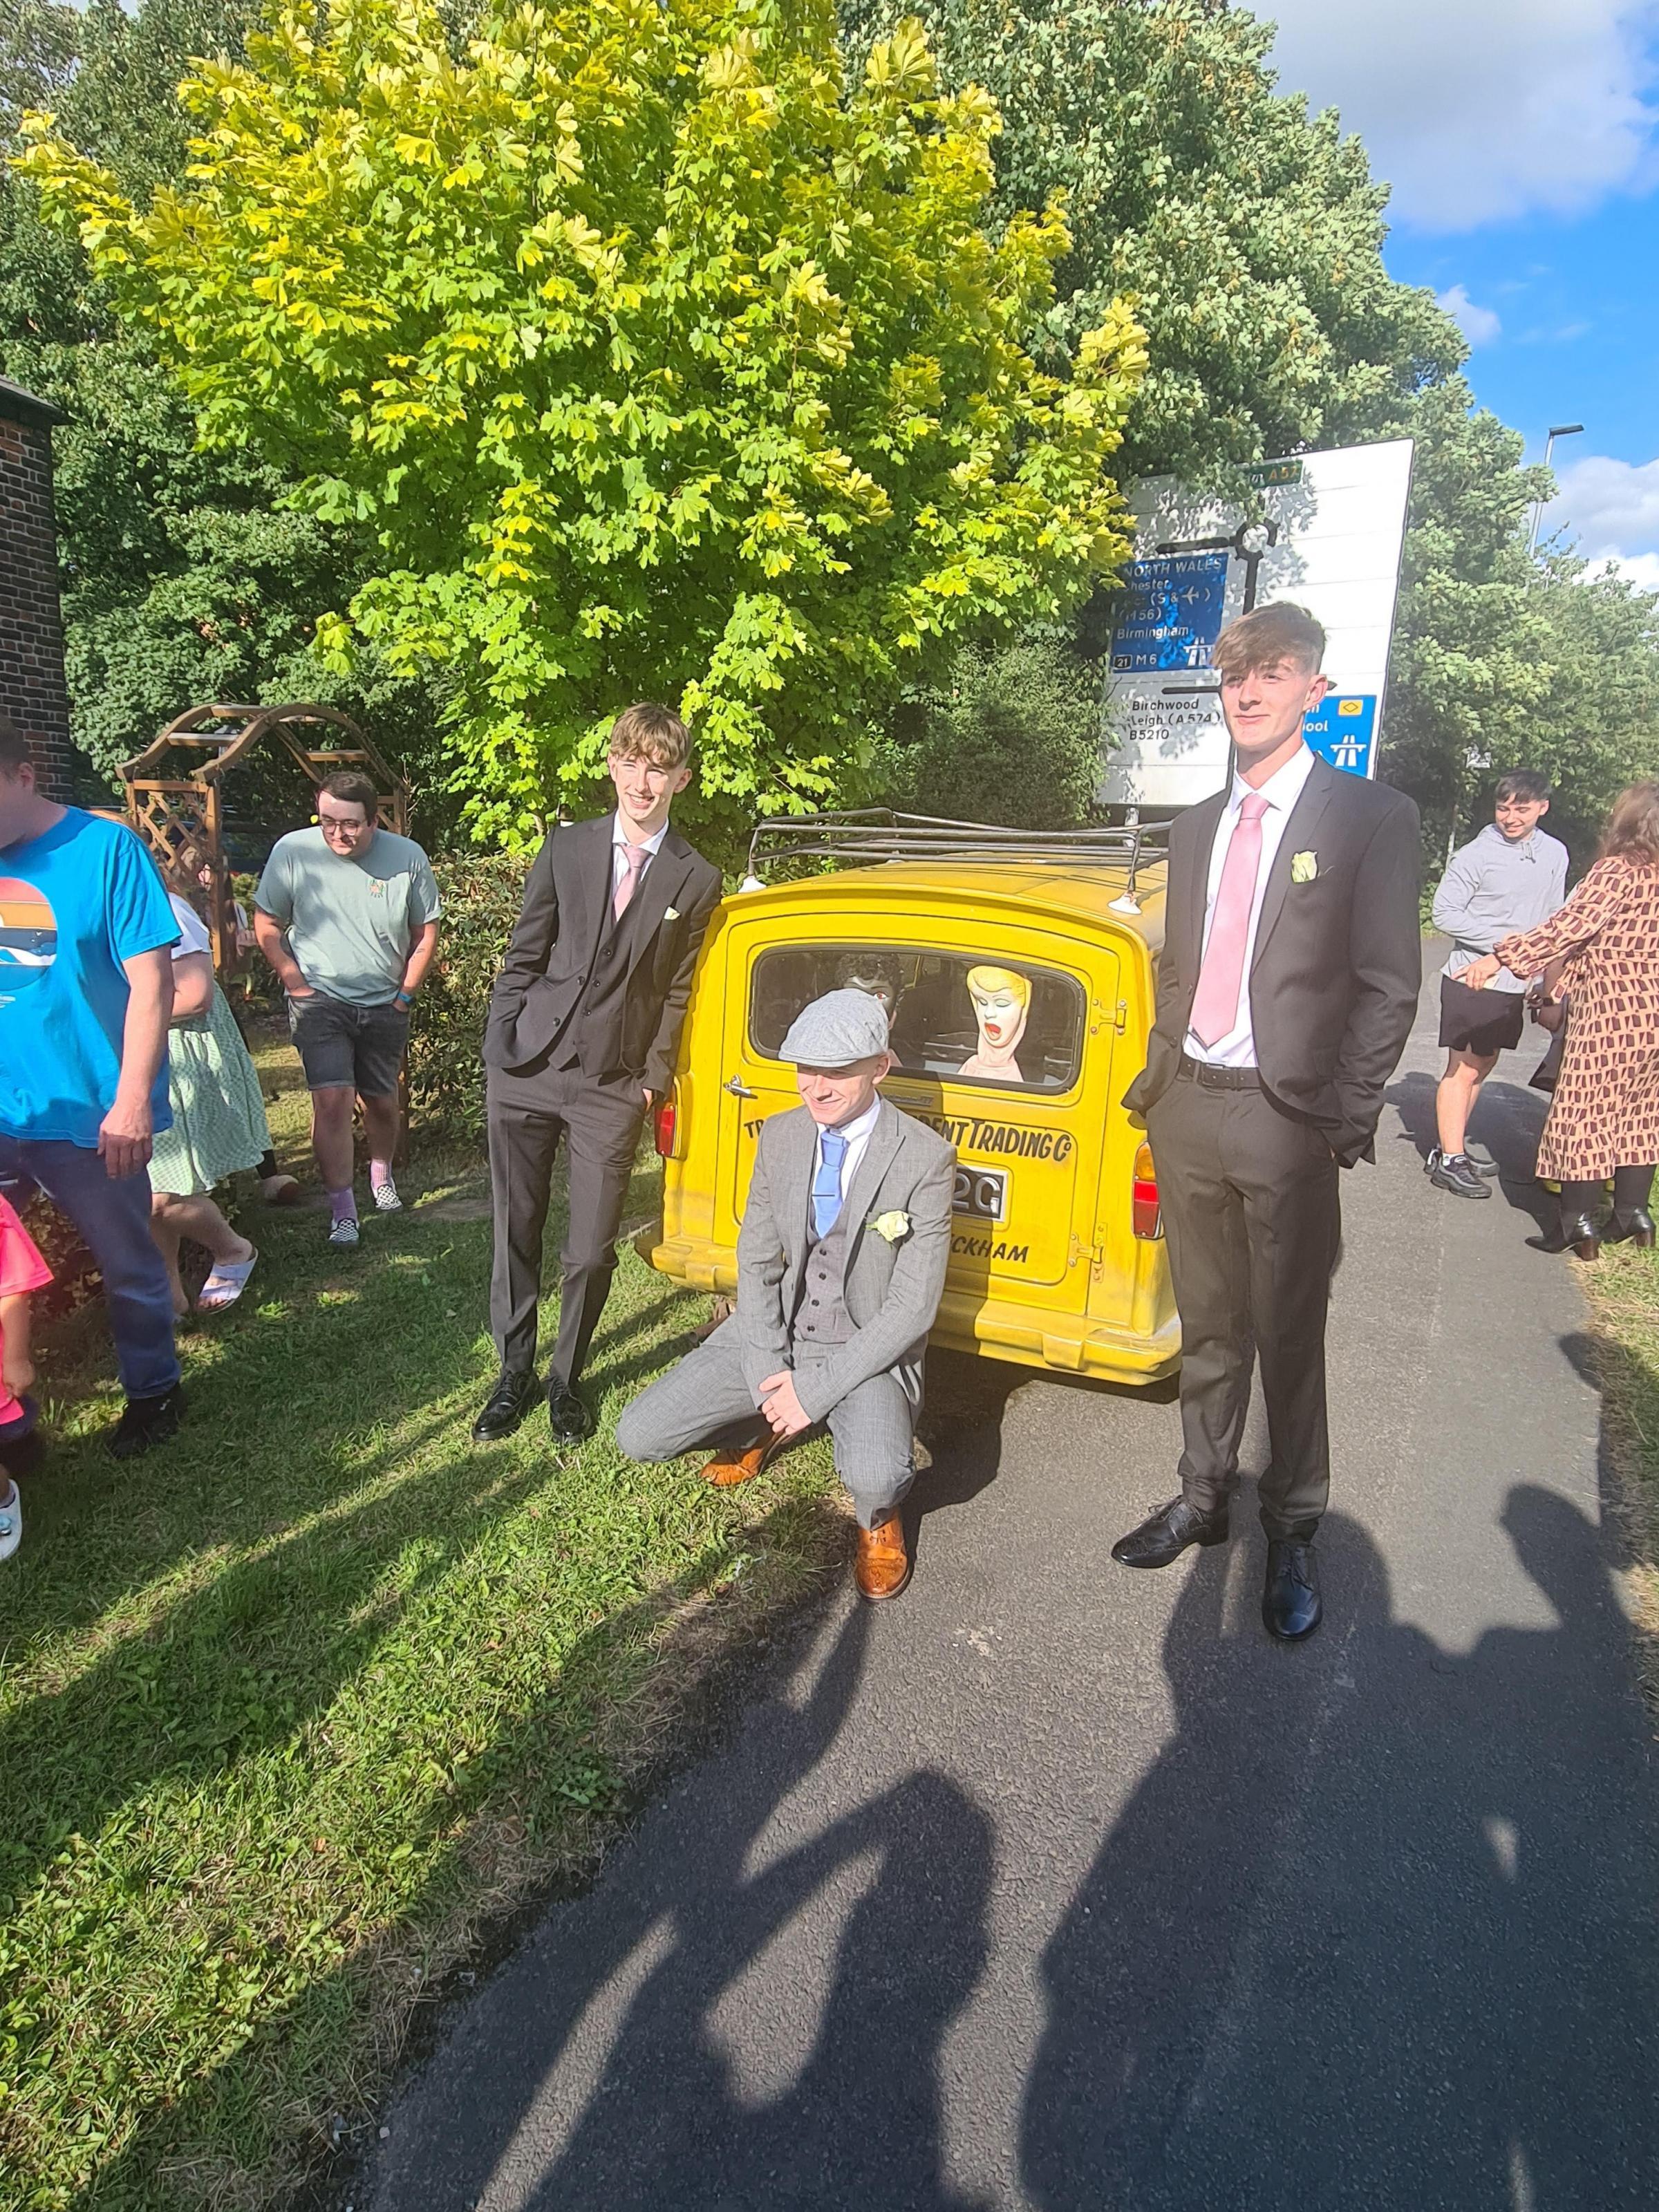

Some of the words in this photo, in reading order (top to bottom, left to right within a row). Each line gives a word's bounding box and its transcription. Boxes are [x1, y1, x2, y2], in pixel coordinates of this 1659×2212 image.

[1175, 557, 1222, 573] WALES
[1117, 626, 1189, 639] Birmingham
[1117, 658, 1128, 667] 21
[1132, 698, 1199, 711] Birchwood
[1132, 714, 1163, 727] Leigh
[1130, 729, 1170, 740] B5210
[968, 1119, 1053, 1159] TRADING
[951, 1232, 1029, 1264] CKHAM
